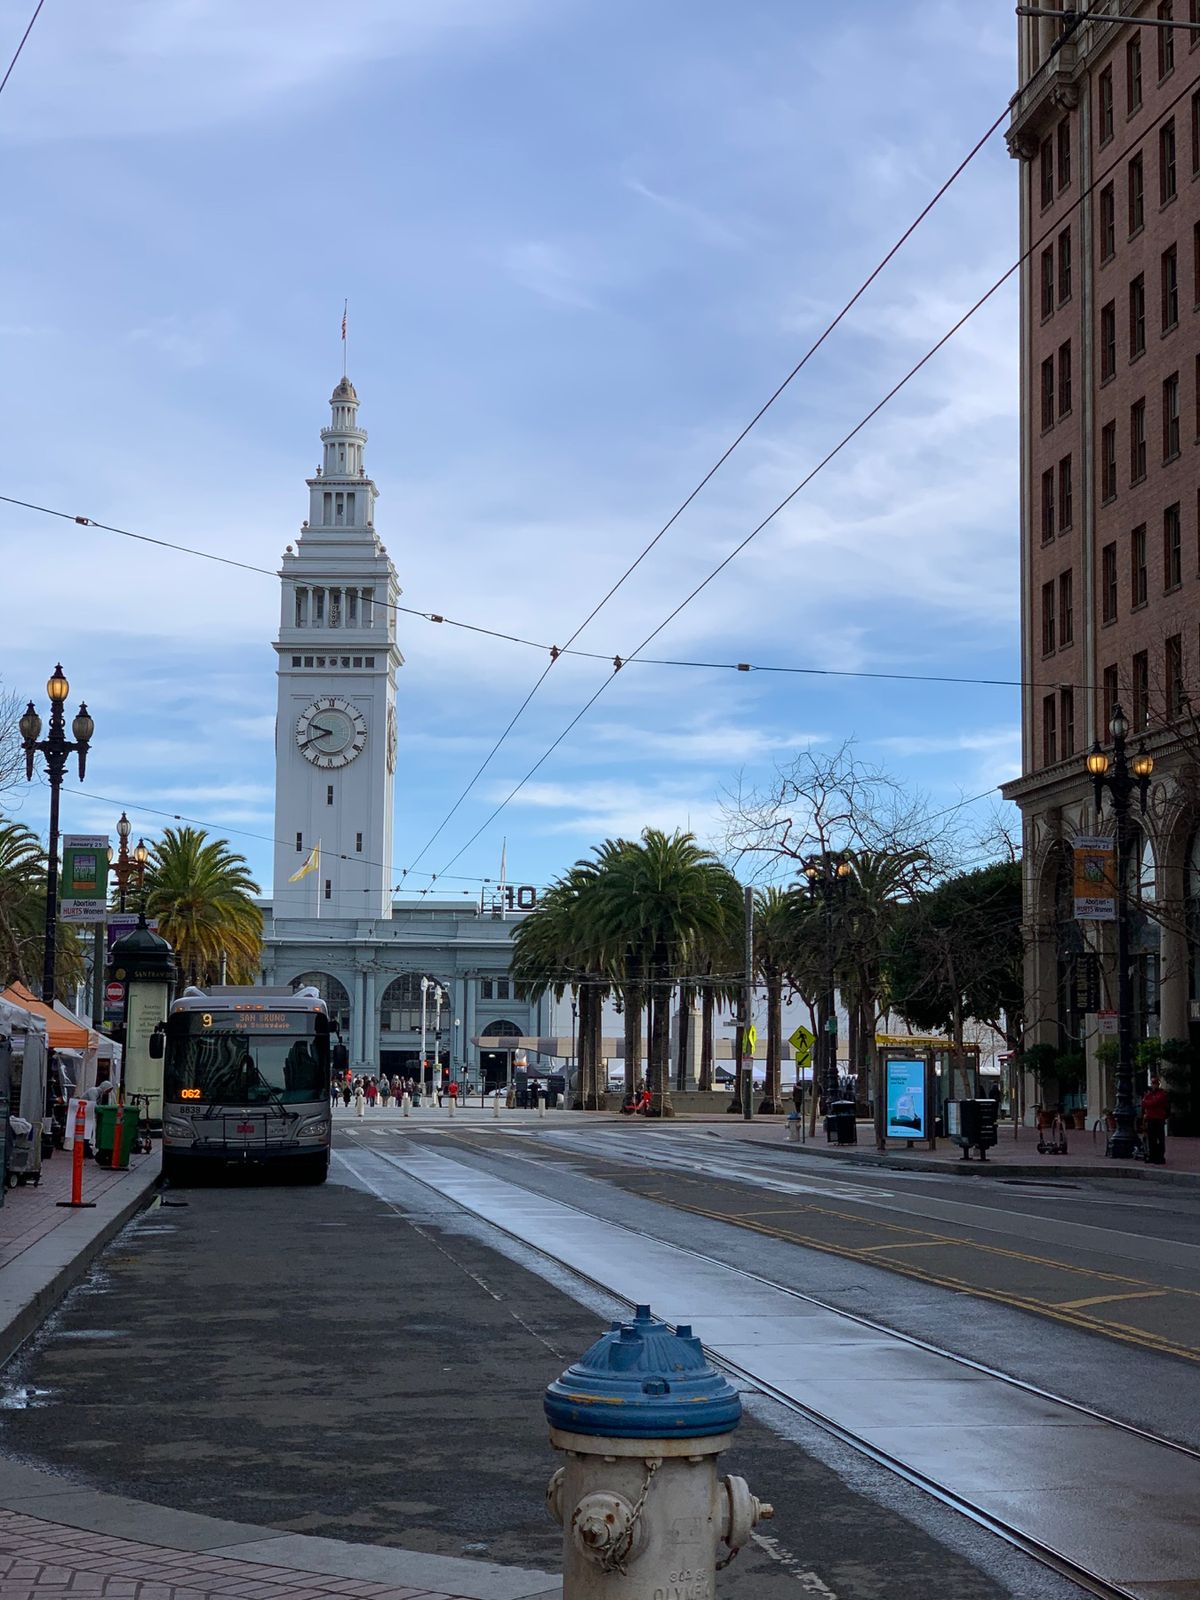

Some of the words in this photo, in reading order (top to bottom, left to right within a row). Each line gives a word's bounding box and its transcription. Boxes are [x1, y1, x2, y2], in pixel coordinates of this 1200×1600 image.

[63, 907, 82, 915] HURTS
[202, 1013, 213, 1027] 9
[240, 1014, 256, 1022] SAN
[181, 1089, 201, 1099] 062
